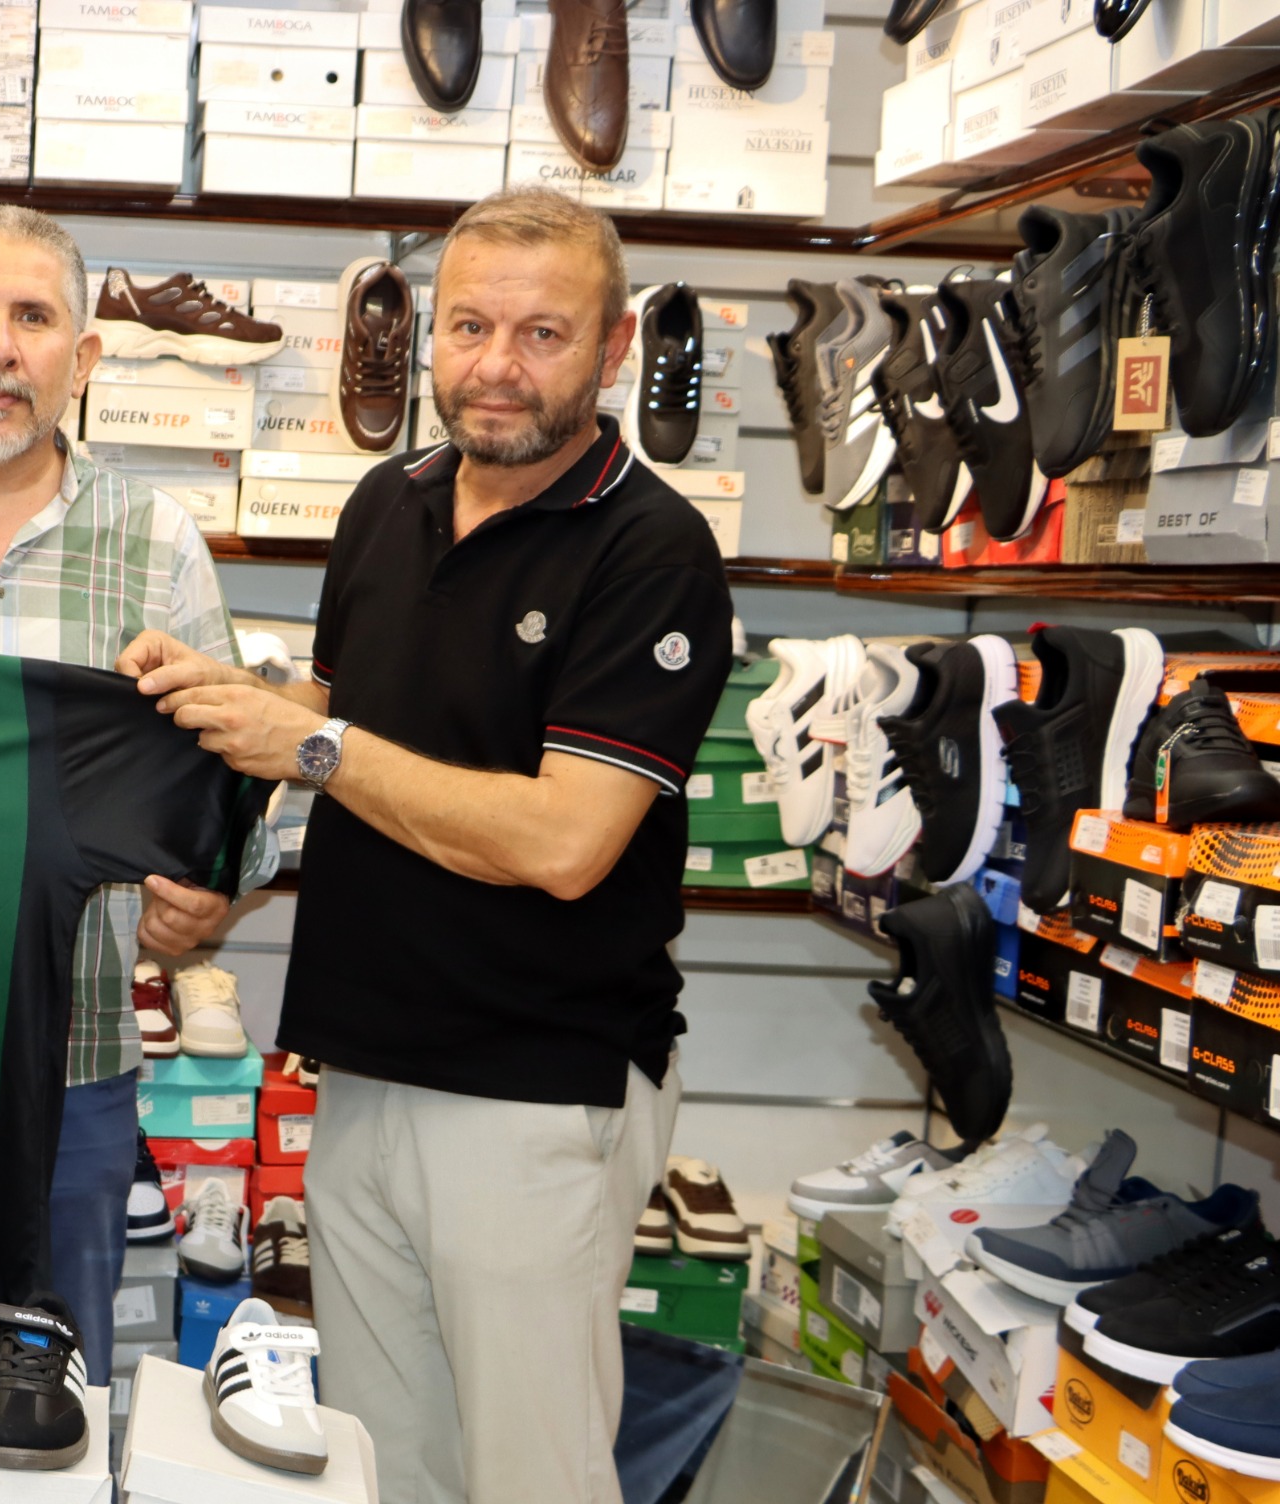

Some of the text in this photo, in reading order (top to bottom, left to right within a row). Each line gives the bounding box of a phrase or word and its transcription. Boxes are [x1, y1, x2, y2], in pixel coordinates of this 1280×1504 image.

[248, 18, 312, 31] TAMBOGA
[410, 116, 468, 127] AMBOGA
[284, 335, 342, 351] EEN STE
[99, 409, 190, 427] QUEEN STEP
[257, 417, 339, 434] QUEEN STE
[250, 501, 341, 519] QUEEN STEP
[1157, 511, 1219, 528] BEST OF
[1089, 894, 1117, 911] G-CLASS
[1126, 1018, 1158, 1038] G-CLASS
[1192, 1046, 1235, 1074] G-CLASS
[15, 1312, 54, 1326] adidas
[264, 1331, 304, 1340] adidas
